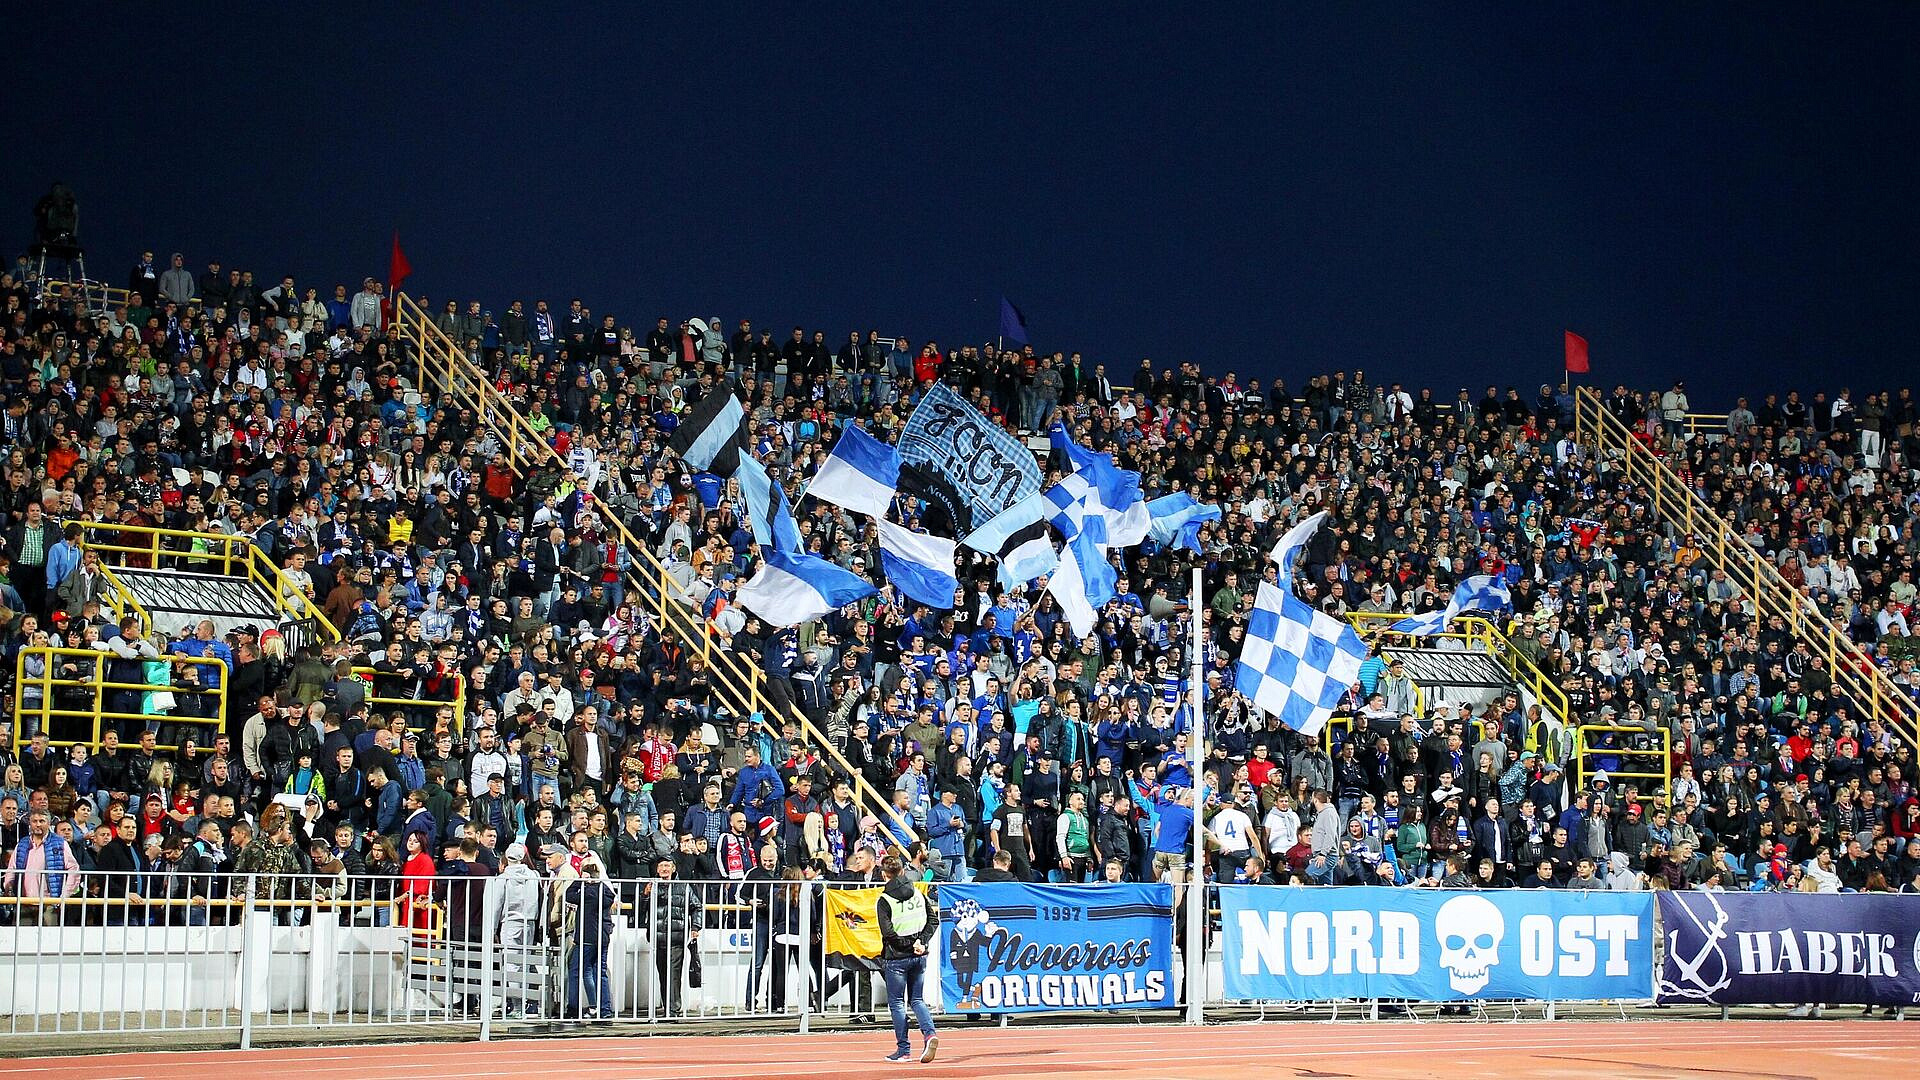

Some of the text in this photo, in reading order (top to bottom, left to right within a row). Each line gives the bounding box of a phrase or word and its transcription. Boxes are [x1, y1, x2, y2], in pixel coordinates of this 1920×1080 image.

[1224, 820, 1236, 838] 4
[1042, 906, 1081, 921] 1997
[988, 928, 1151, 972] Novoross
[1238, 909, 1638, 977] NORD OST
[1735, 928, 1898, 978] НАВЕК
[981, 970, 1165, 1007] ORIGINALS
